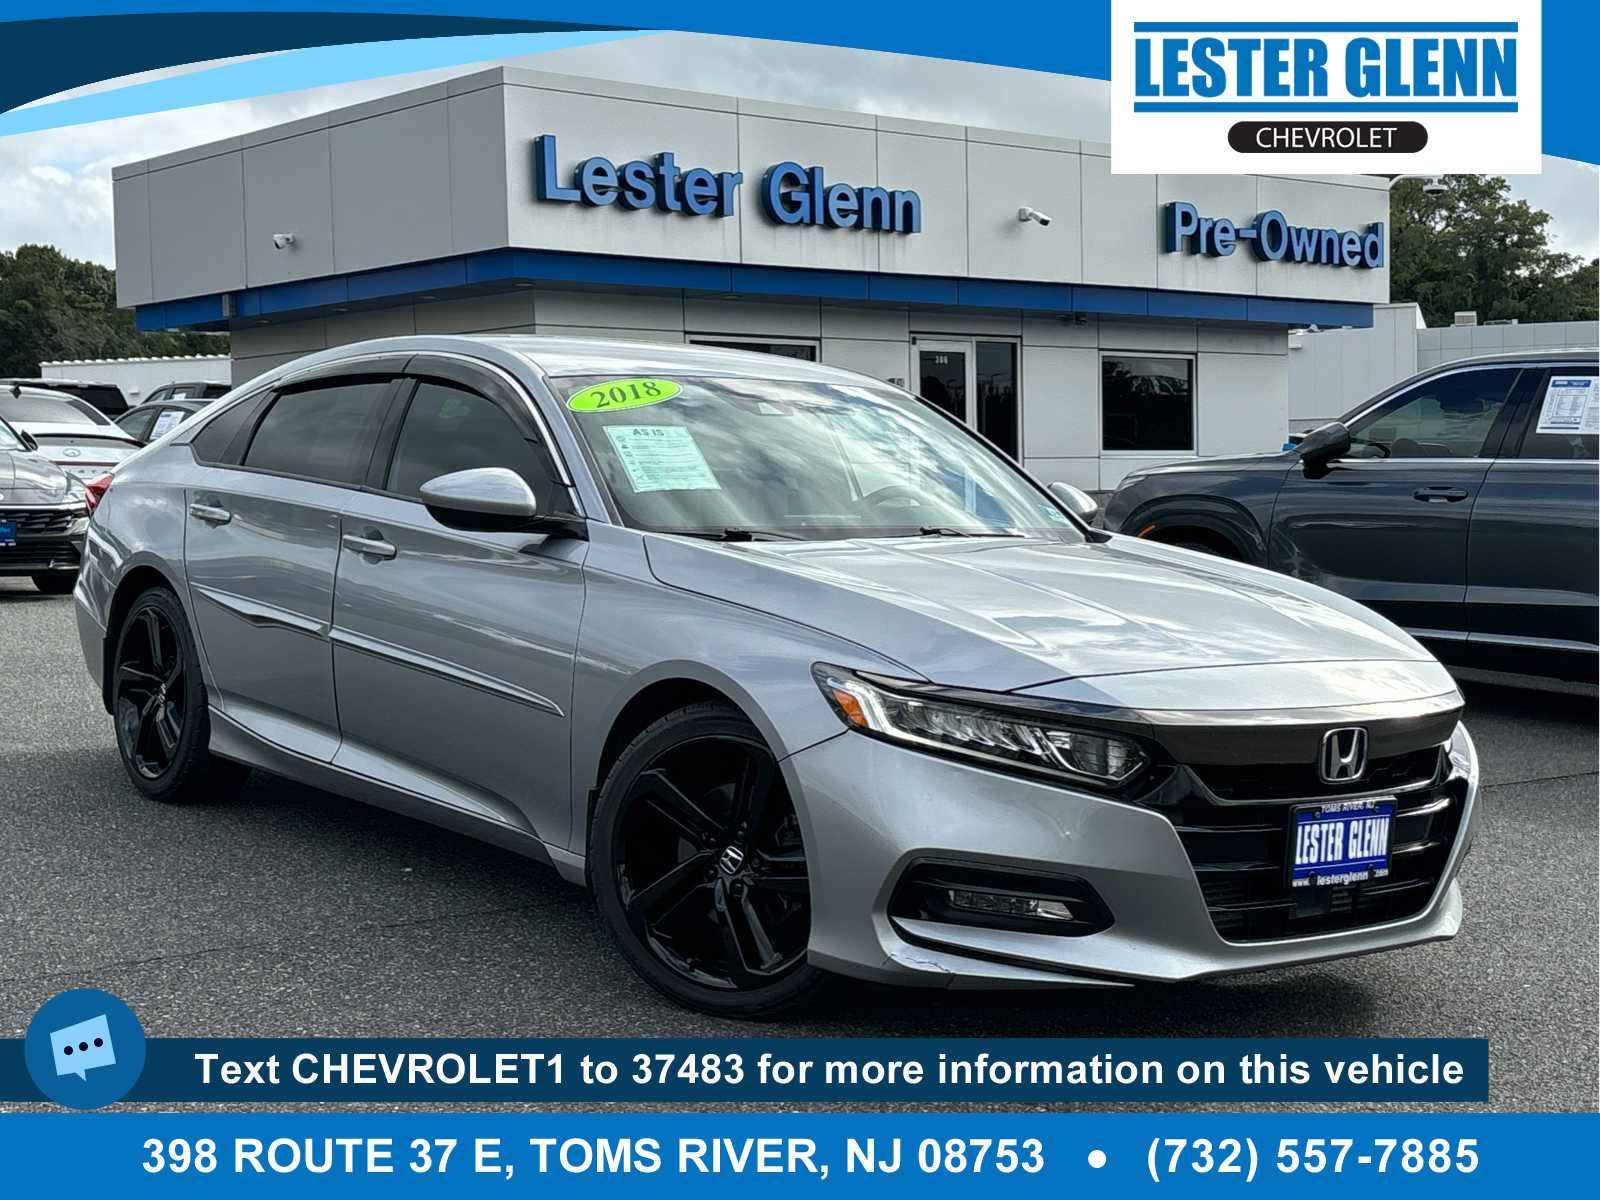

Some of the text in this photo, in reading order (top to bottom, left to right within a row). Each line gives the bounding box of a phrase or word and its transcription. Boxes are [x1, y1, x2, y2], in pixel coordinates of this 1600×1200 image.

[535, 135, 922, 234] Lester Glenn
[1165, 201, 1385, 268] Pre-Owned
[590, 381, 662, 408] 2018
[1295, 817, 1390, 865] LESTER GLENN
[1316, 871, 1369, 886] lesterglenn
